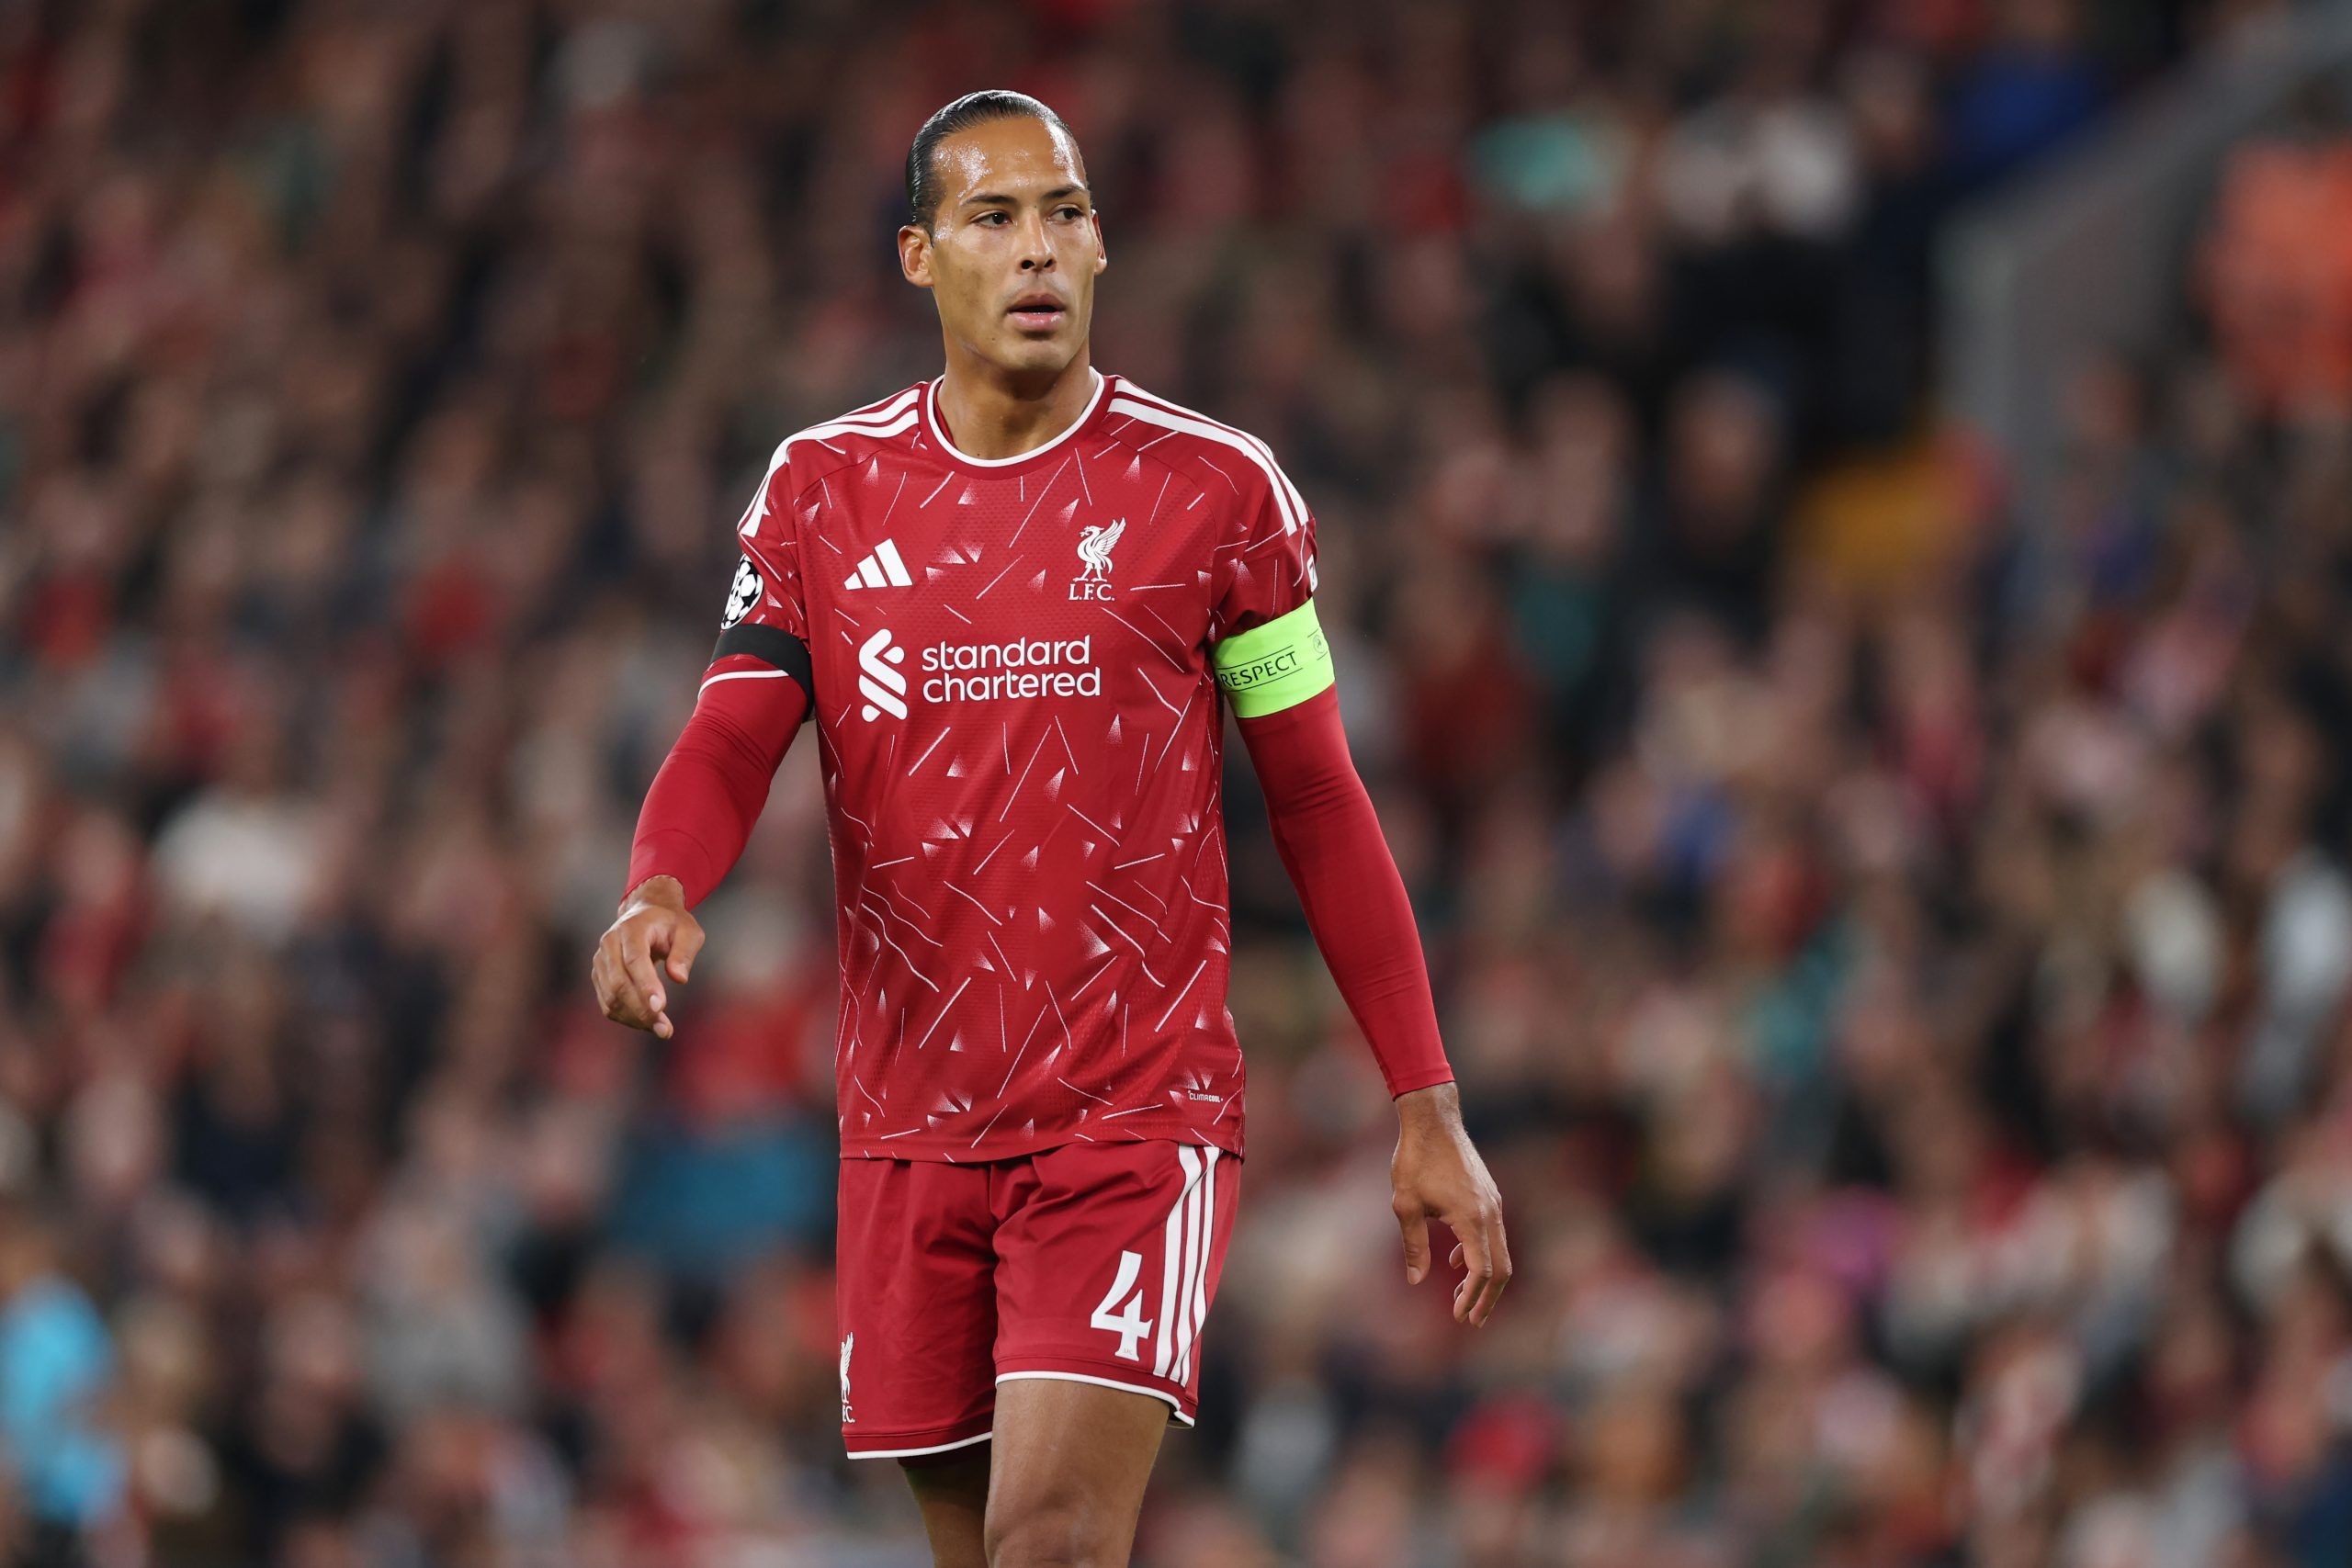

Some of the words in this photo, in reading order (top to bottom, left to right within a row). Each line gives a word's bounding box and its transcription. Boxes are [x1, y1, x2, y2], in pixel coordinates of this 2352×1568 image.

[1069, 583, 1115, 602] L.F.C.
[922, 634, 1091, 671] standard
[1219, 650, 1297, 687] RESPECT
[922, 666, 1102, 704] chartered
[1090, 1249, 1154, 1362] 4
